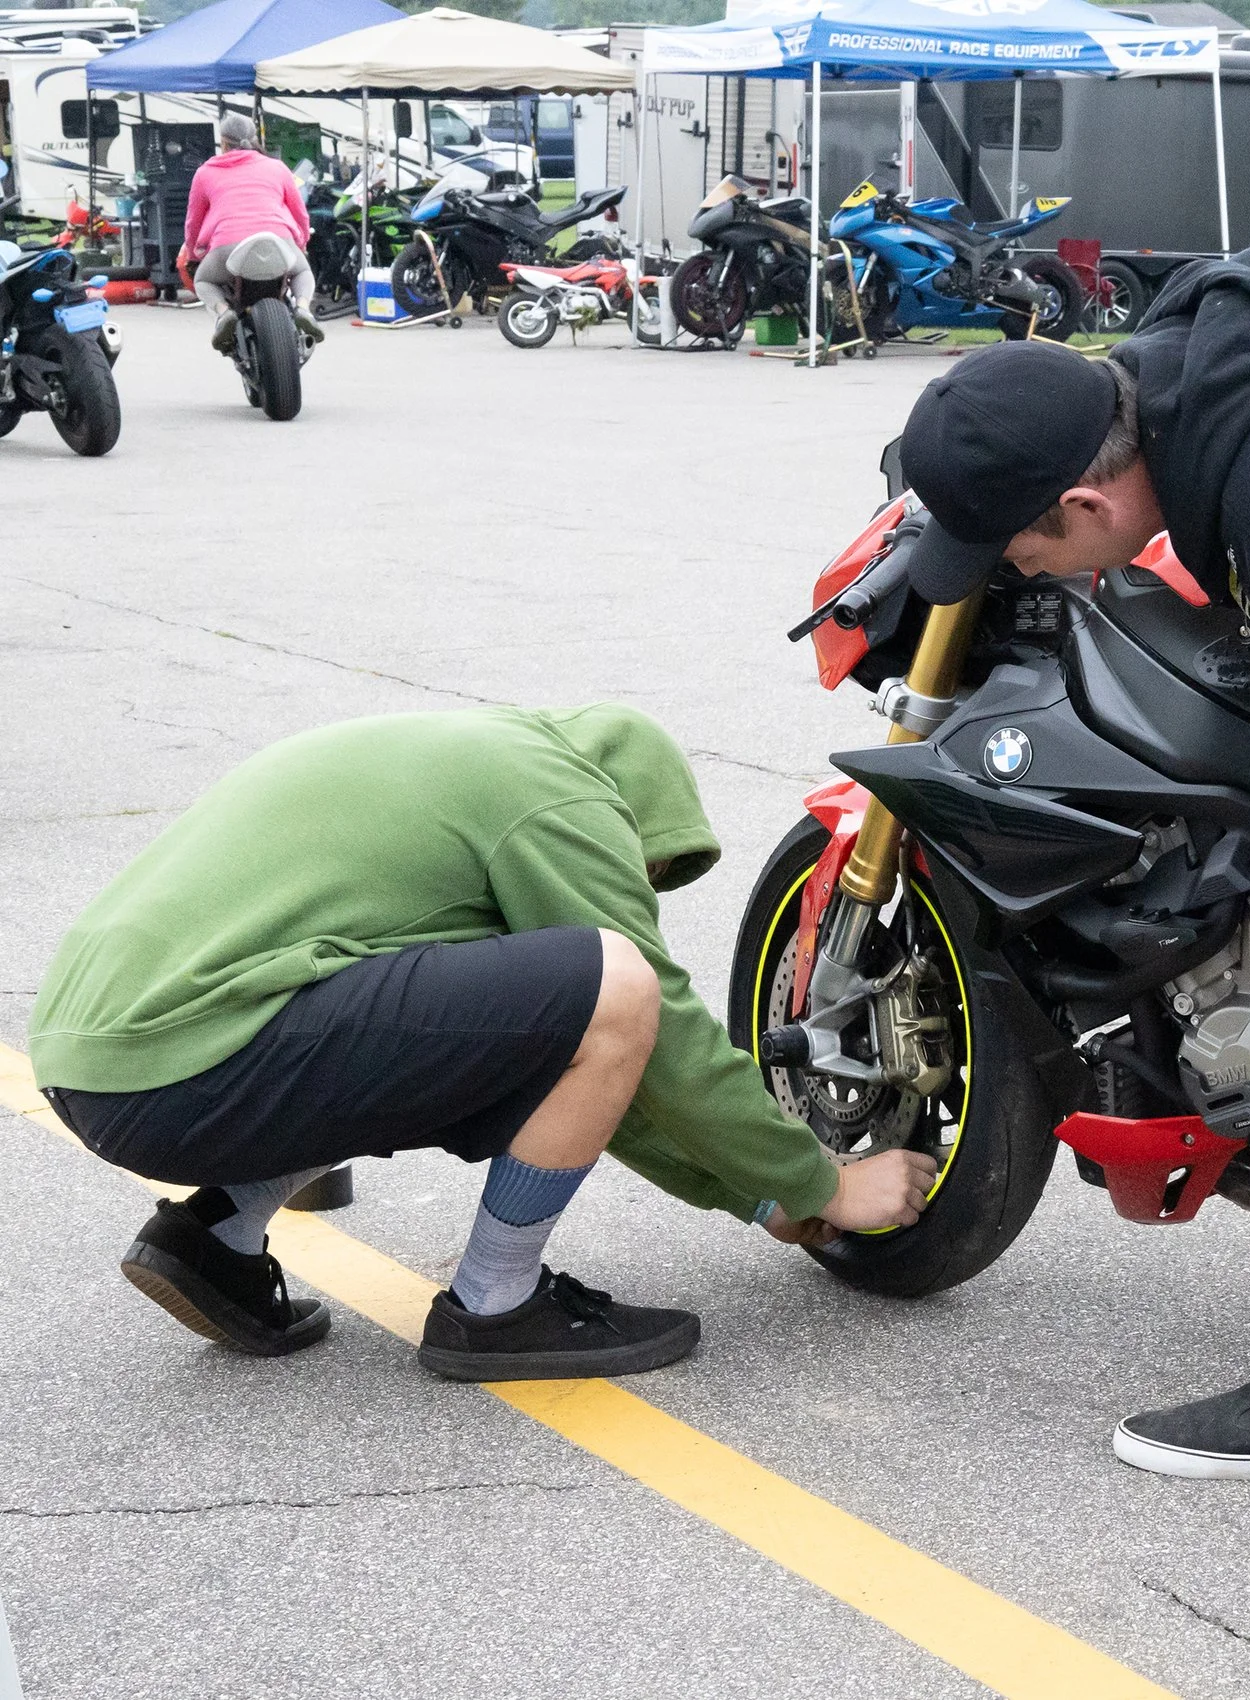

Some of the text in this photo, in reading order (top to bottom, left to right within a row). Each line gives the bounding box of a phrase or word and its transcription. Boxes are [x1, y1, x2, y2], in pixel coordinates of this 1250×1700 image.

[829, 33, 943, 53] PROFESSIONAL
[950, 42, 989, 56] RACE
[994, 44, 1083, 59] EQUIPMENT
[1118, 40, 1211, 57] FLY
[668, 97, 695, 119] PUP
[987, 730, 1027, 750] BMW
[1205, 1063, 1247, 1087] BMW
